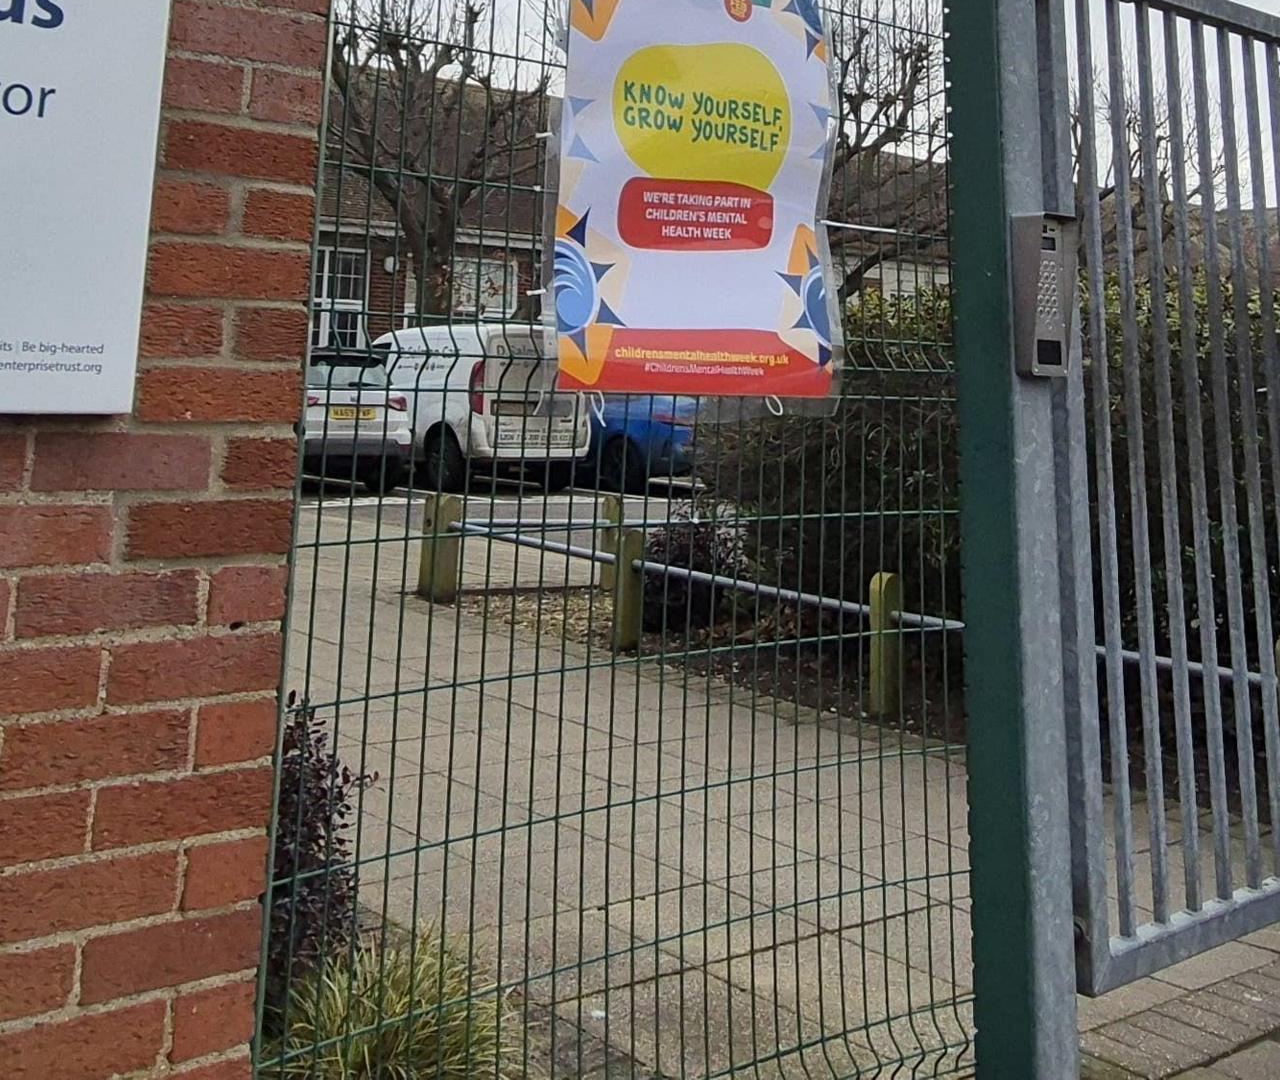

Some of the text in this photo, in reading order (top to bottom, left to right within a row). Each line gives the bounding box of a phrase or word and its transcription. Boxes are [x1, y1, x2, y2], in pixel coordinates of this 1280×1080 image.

[624, 80, 783, 131] KNOW YOURSELF,
[623, 106, 683, 133] GROW
[643, 191, 751, 209] WE'RE TAKING PART IN
[645, 208, 748, 225] CHILDREN'S MENTAL
[662, 225, 732, 239] HEALTH WEEK
[22, 341, 36, 352] Be
[38, 342, 104, 355] big-hearted
[615, 346, 789, 367] childrensmentalhealthweek.org.uk
